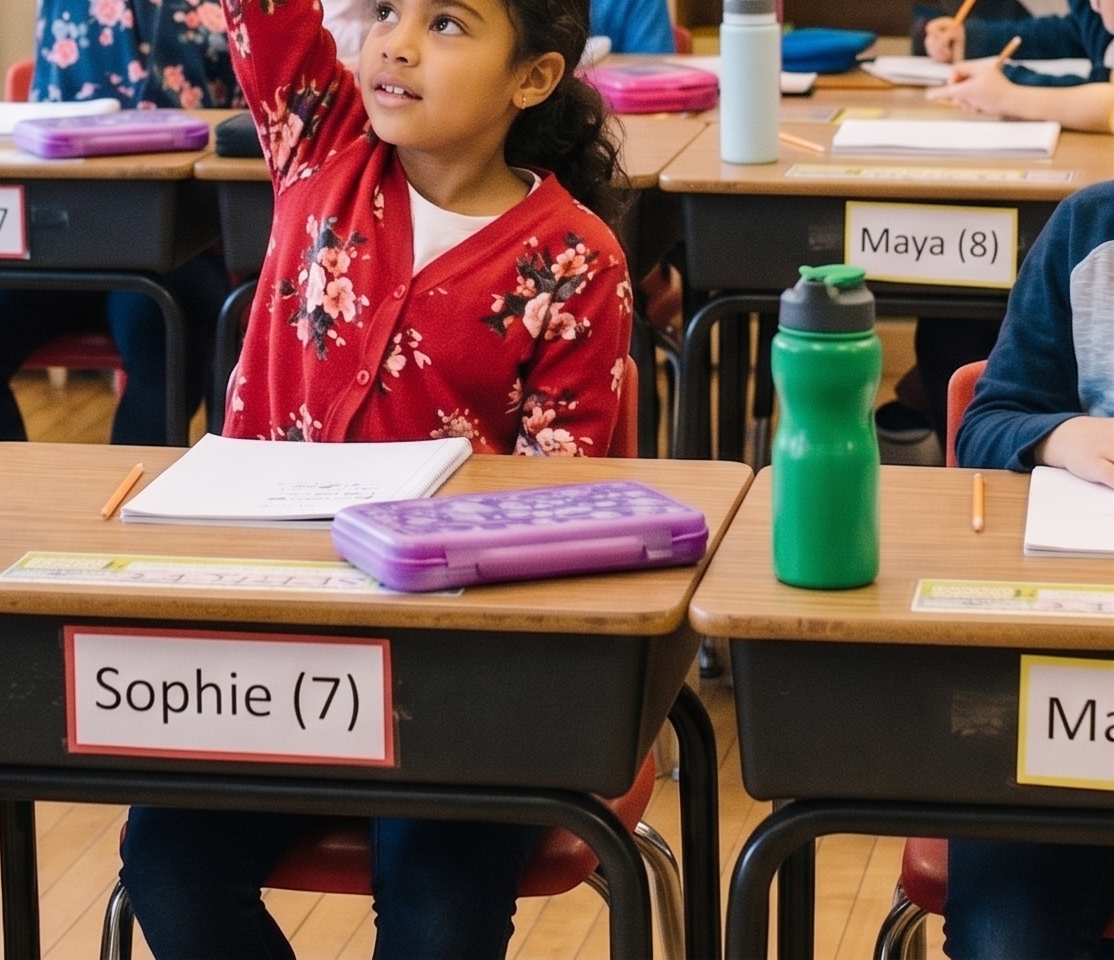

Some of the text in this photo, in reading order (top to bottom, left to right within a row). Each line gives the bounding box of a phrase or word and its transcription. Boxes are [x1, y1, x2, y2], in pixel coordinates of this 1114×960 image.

[860, 227, 1000, 264] Maya (8)
[95, 666, 360, 732] Sophie (7)
